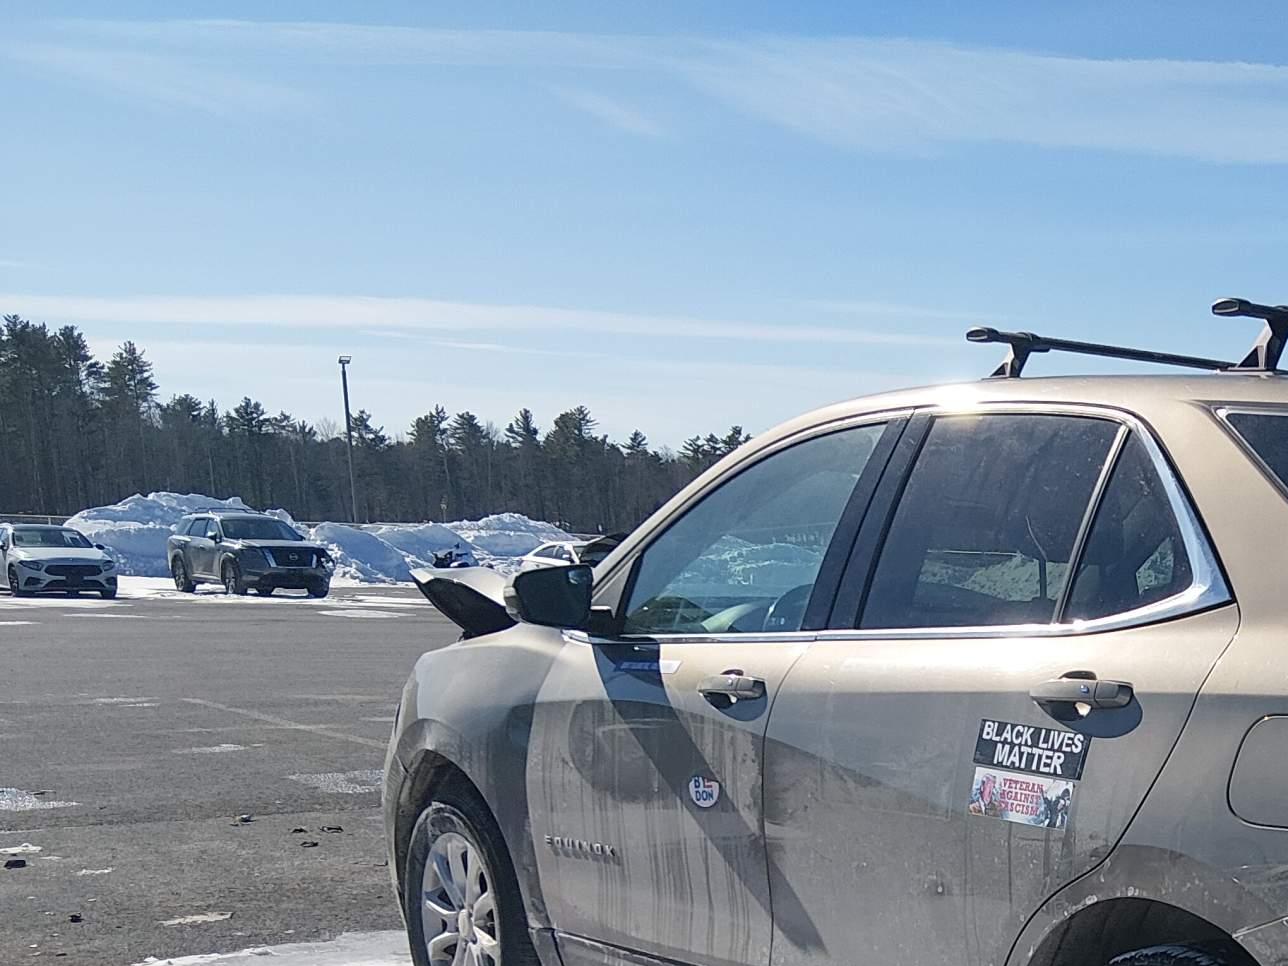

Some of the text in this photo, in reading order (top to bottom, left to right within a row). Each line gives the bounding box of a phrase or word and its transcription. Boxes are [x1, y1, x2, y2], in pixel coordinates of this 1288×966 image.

[982, 720, 1085, 754] BLACK LIVES
[993, 743, 1065, 775] MATTER
[694, 789, 714, 802] DON
[1002, 778, 1044, 794] VETERAN
[1000, 789, 1041, 806] AGAINST
[543, 833, 616, 857] EQUINOX
